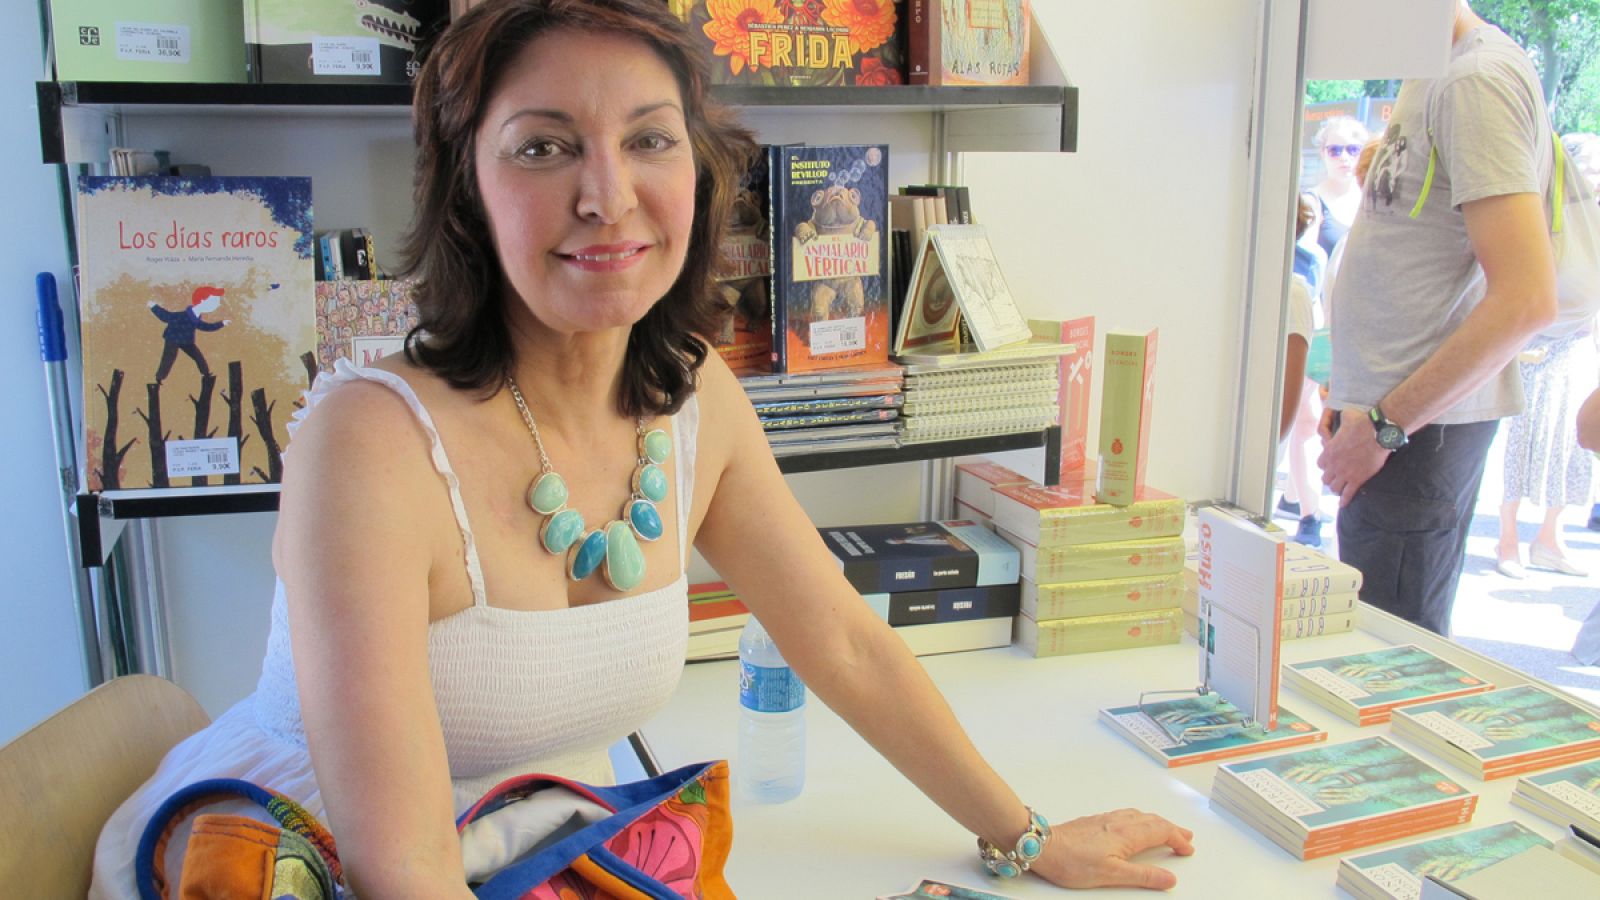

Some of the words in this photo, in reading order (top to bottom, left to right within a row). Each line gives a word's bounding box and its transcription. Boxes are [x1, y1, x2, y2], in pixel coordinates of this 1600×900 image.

[749, 31, 854, 69] FRIDA
[952, 60, 981, 74] ALAS
[989, 61, 1020, 76] ROTAS
[792, 161, 831, 169] INSTITUTO
[792, 170, 828, 179] REVILLOD
[119, 220, 157, 249] Los
[166, 220, 213, 249] días
[221, 231, 279, 248] raros
[805, 242, 869, 258] ANIMALARIO
[804, 256, 869, 277] VERTICAL
